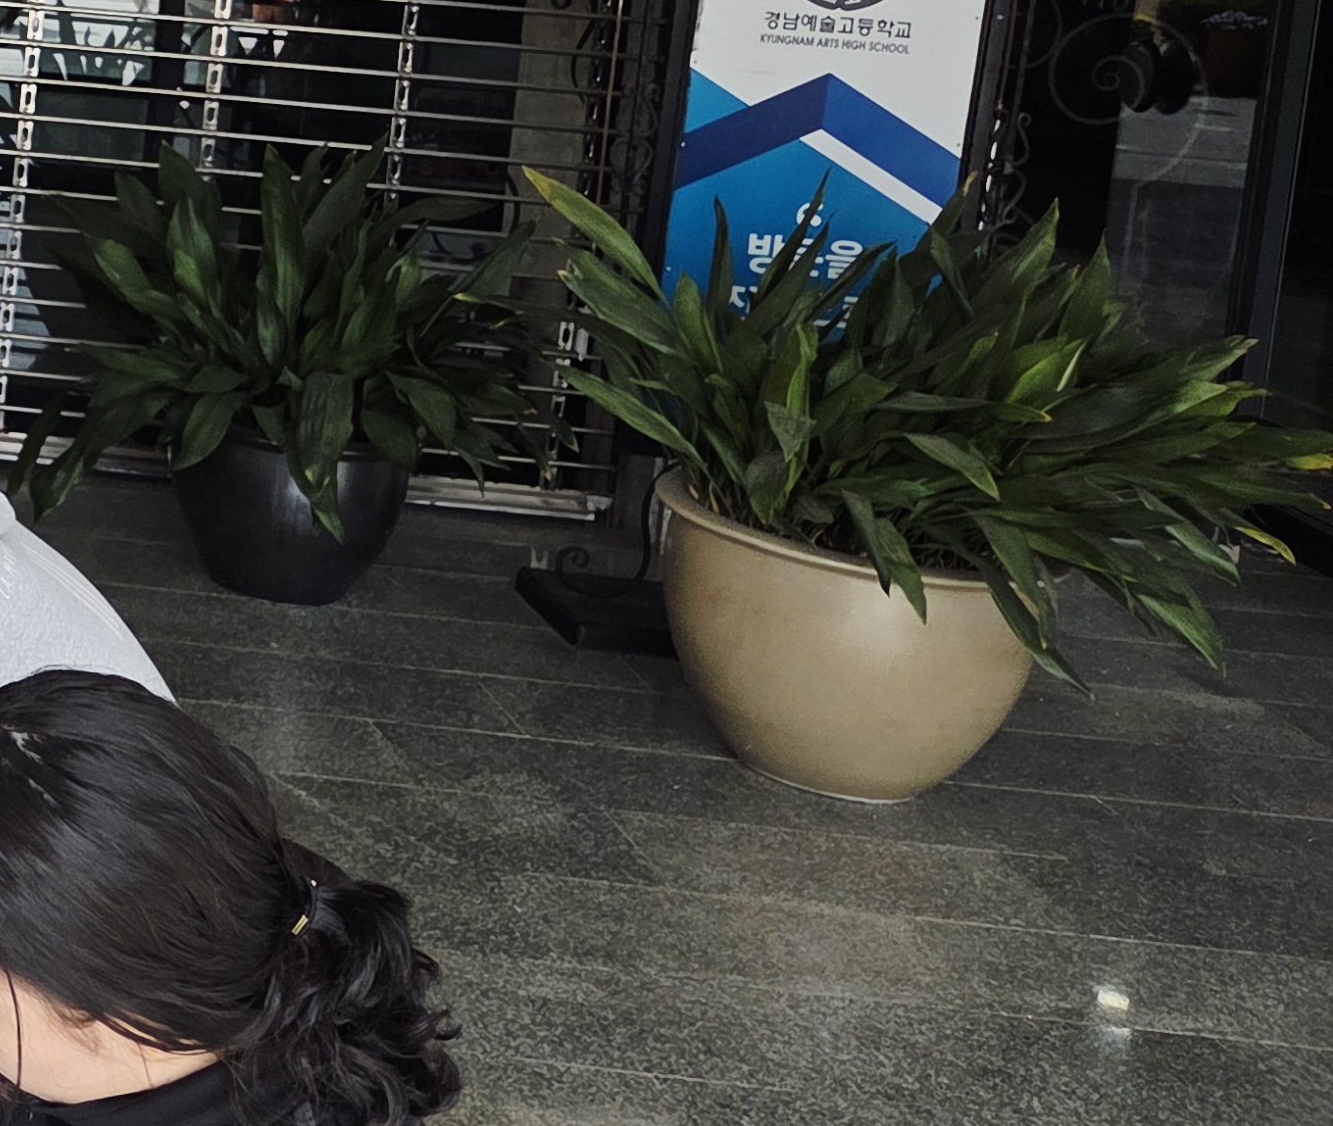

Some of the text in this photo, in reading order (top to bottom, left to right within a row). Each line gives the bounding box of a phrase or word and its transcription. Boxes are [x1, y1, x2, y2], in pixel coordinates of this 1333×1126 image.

[764, 11, 912, 39] 경남예술고등학교
[760, 34, 910, 55] KYUNGNAM ARTS HIGH SCHOOL
